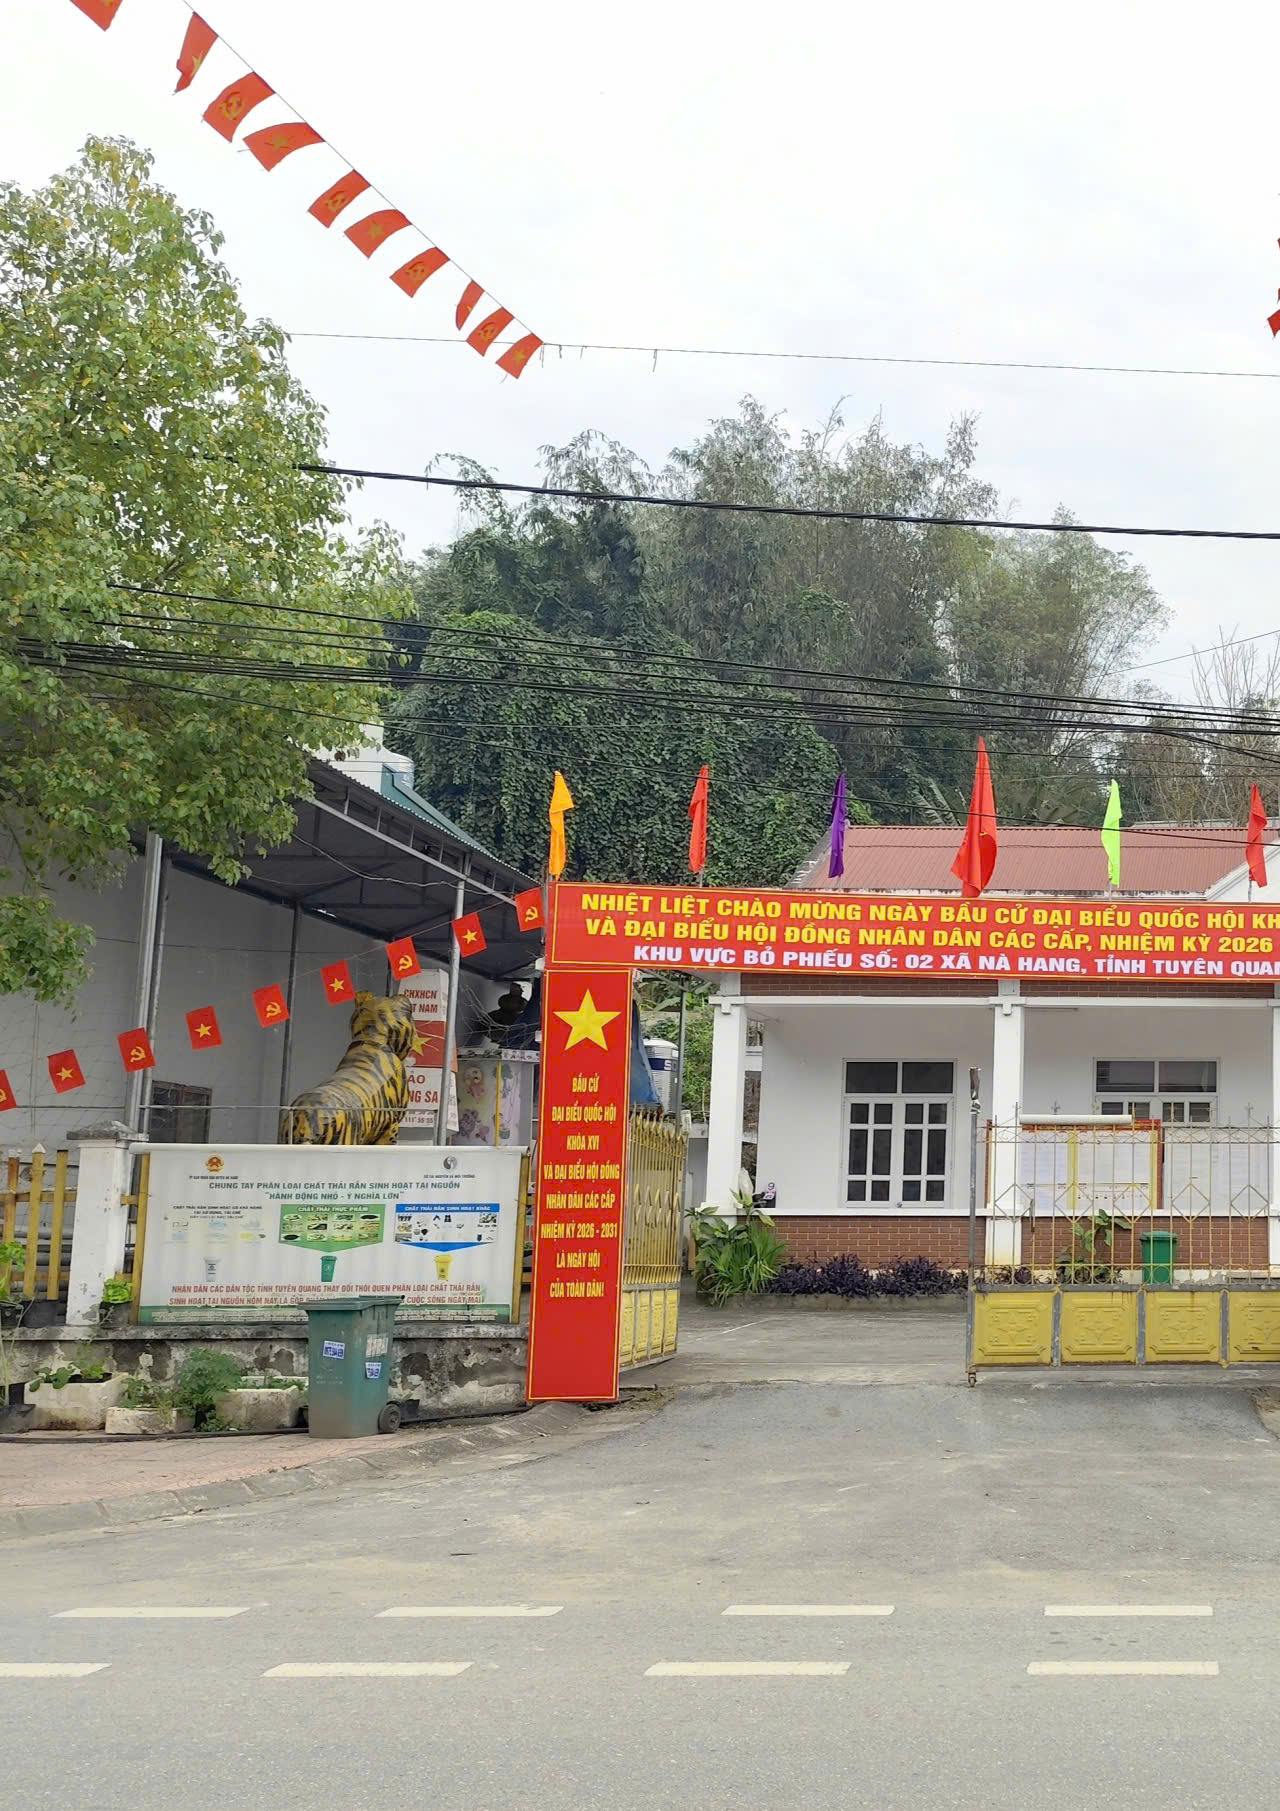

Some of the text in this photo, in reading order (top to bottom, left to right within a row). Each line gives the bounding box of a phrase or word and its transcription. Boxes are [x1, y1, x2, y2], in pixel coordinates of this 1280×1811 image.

[582, 892, 653, 914] NHIỆT
[660, 895, 710, 917] LIỆT
[717, 897, 781, 919] CHÀO
[789, 898, 862, 922] MỪNG
[869, 900, 933, 923] NGÀY
[940, 902, 987, 925] BẦU
[995, 903, 1028, 925] CỬ
[1033, 908, 1072, 929] ĐẠI
[1080, 905, 1132, 928] BIỂU
[1139, 907, 1200, 930] QUỐC
[1207, 911, 1245, 933] HỘI
[586, 918, 617, 937] VÀ
[624, 920, 664, 941] ĐẠI
[673, 916, 729, 941] BIỂU
[736, 922, 777, 947] HỘI
[784, 921, 851, 945] ĐỒNG
[858, 925, 925, 946] NHÂN
[933, 926, 982, 948] DÂN
[989, 928, 1036, 949] CÁC
[1043, 928, 1092, 953] CẤP,
[1100, 931, 1175, 955] NHIỆM
[1182, 932, 1211, 953] KỲ
[1218, 937, 1273, 953] 2026
[634, 945, 682, 963] KHU
[689, 946, 736, 966] VỰC
[744, 945, 776, 966] BỎ
[783, 946, 852, 969] PHIẾU
[860, 948, 898, 969] SỐ:
[905, 954, 934, 969] 02
[940, 951, 971, 970] XÃ
[978, 952, 1011, 971] NÀ
[1018, 956, 1087, 975] HANG,
[1094, 953, 1146, 974] TỈNH
[1152, 954, 1225, 975] TUYÊN
[572, 1075, 599, 1092] BẦU CỬ
[424, 1090, 439, 1103] SA
[552, 1101, 616, 1125] ĐẠI BIỂU QUỐC HỘI
[567, 1134, 599, 1150] KHÓA XVI
[544, 1159, 620, 1184] VÀ ĐẠI BIỂU HỘI ĐỒNG
[546, 1189, 615, 1209] NHÂN DÂN CÁC CẤP
[541, 1221, 564, 1242] NHIỆM
[566, 1221, 576, 1238] KỲ
[577, 1224, 594, 1238] 2026
[601, 1223, 617, 1238] 2031
[556, 1251, 600, 1271] LÀ NGÀY HỘI
[298, 1285, 321, 1294] QUANG
[550, 1278, 604, 1297] CỦA TOÀN DÂN!
